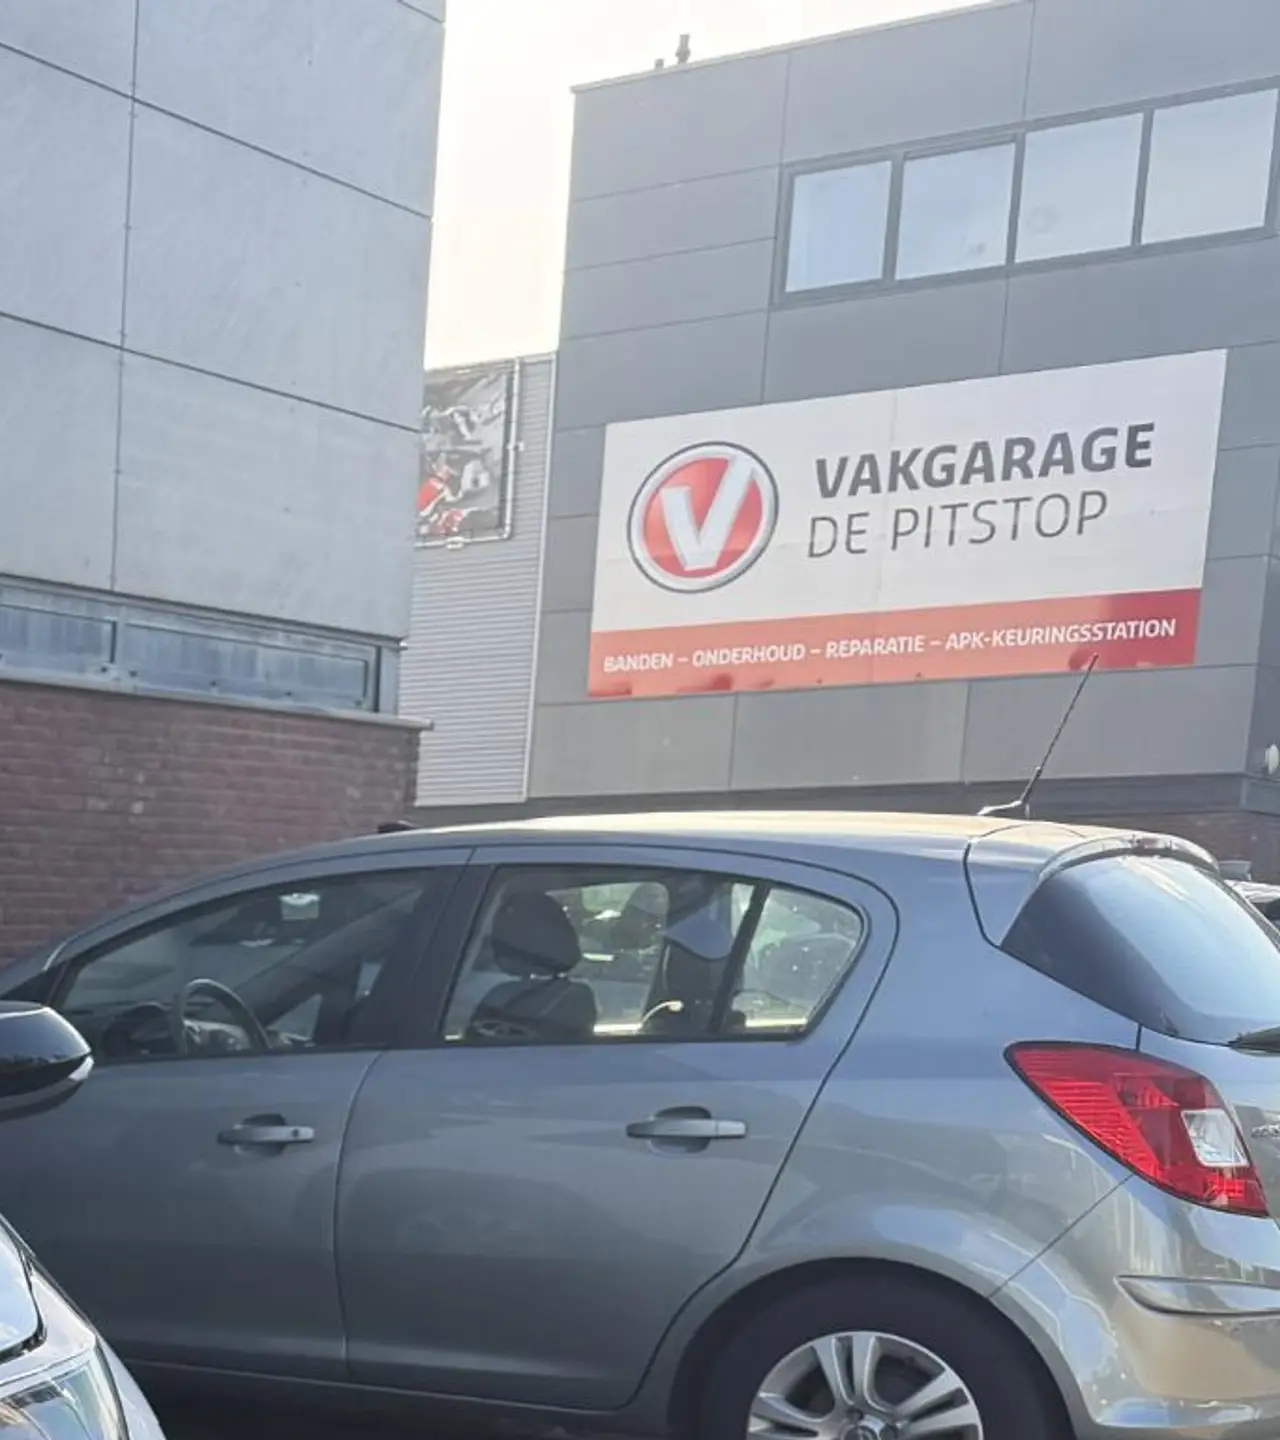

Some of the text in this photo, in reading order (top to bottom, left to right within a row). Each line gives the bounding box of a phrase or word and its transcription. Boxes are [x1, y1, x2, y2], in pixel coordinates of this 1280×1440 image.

[815, 422, 1155, 499] VAKGARAGE
[660, 454, 756, 572] V
[808, 490, 1108, 558] DE PITSTOP
[603, 652, 674, 673] BANDEN
[692, 643, 806, 668] ONDERHOUD
[825, 634, 925, 659] REPARATIE
[945, 618, 1177, 651] APK-KEURINGSSTATION
